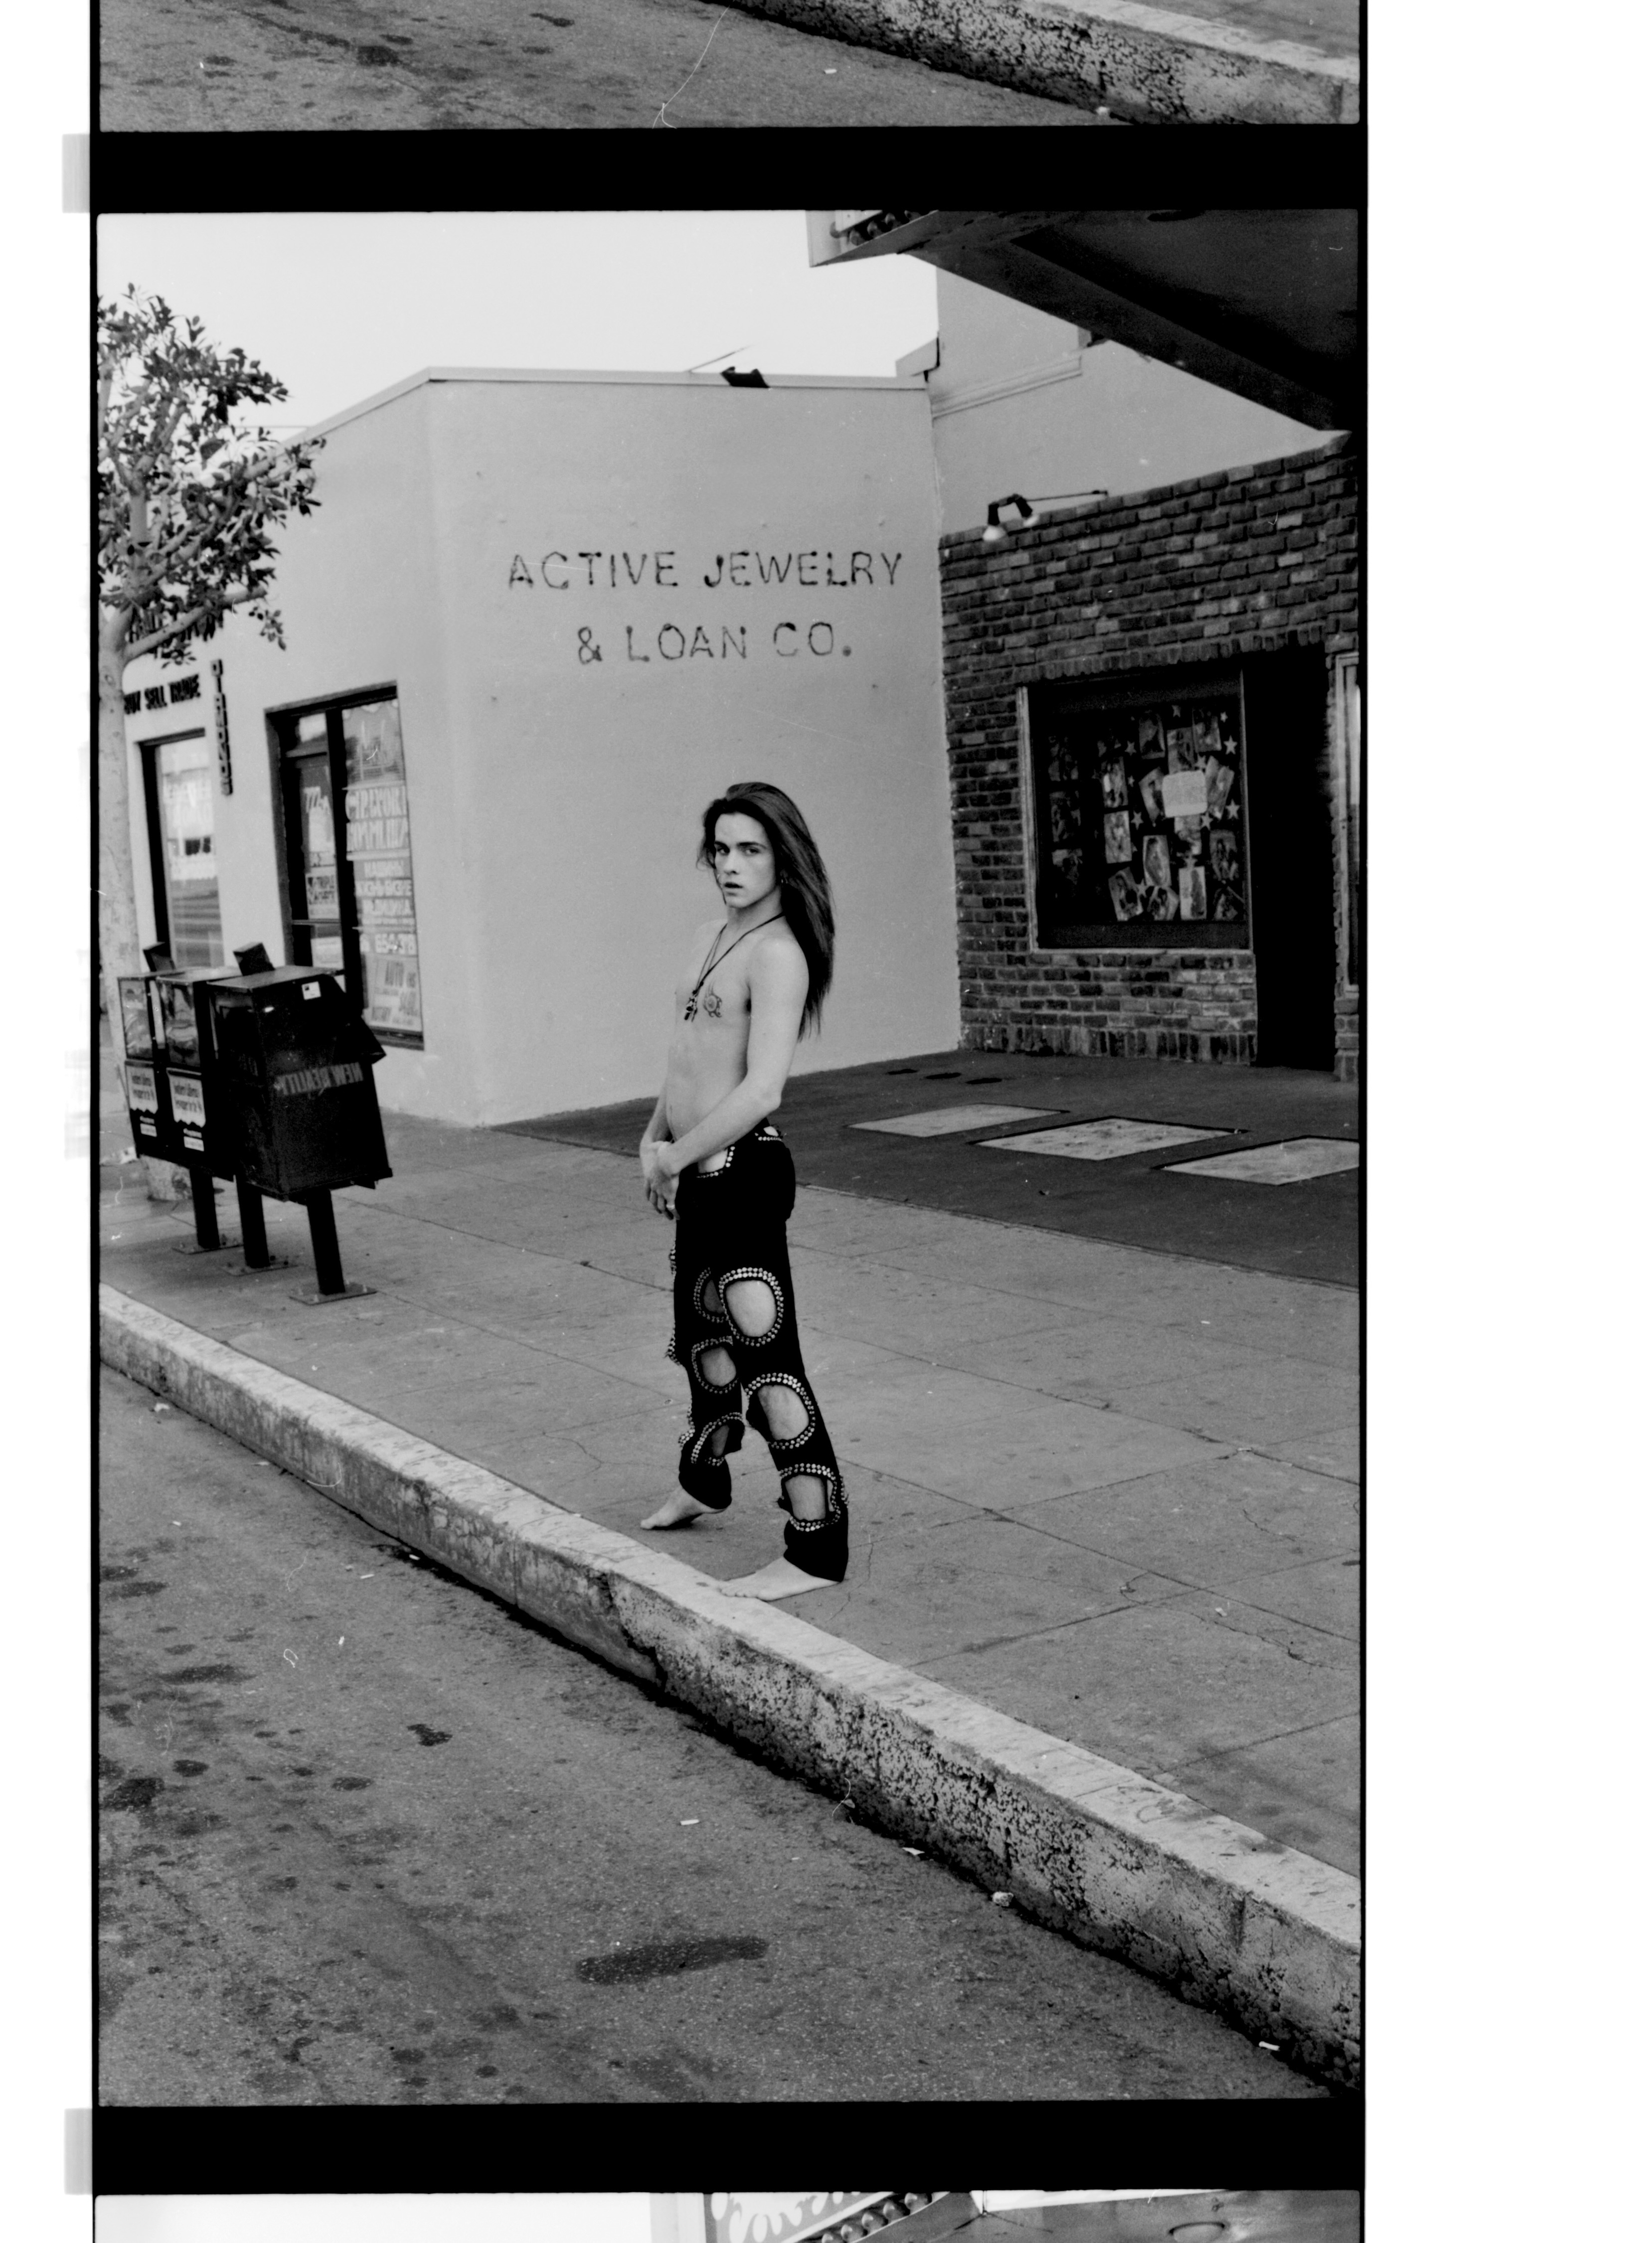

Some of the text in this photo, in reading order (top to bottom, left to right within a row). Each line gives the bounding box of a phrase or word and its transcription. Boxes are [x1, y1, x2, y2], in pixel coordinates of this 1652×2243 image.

[508, 549, 902, 589] ACTIVE JEWELRY
[578, 622, 852, 664] & LOAN CO.
[144, 685, 167, 710] SELL
[168, 674, 200, 703] TRADE
[210, 659, 233, 796] DIAMONDS
